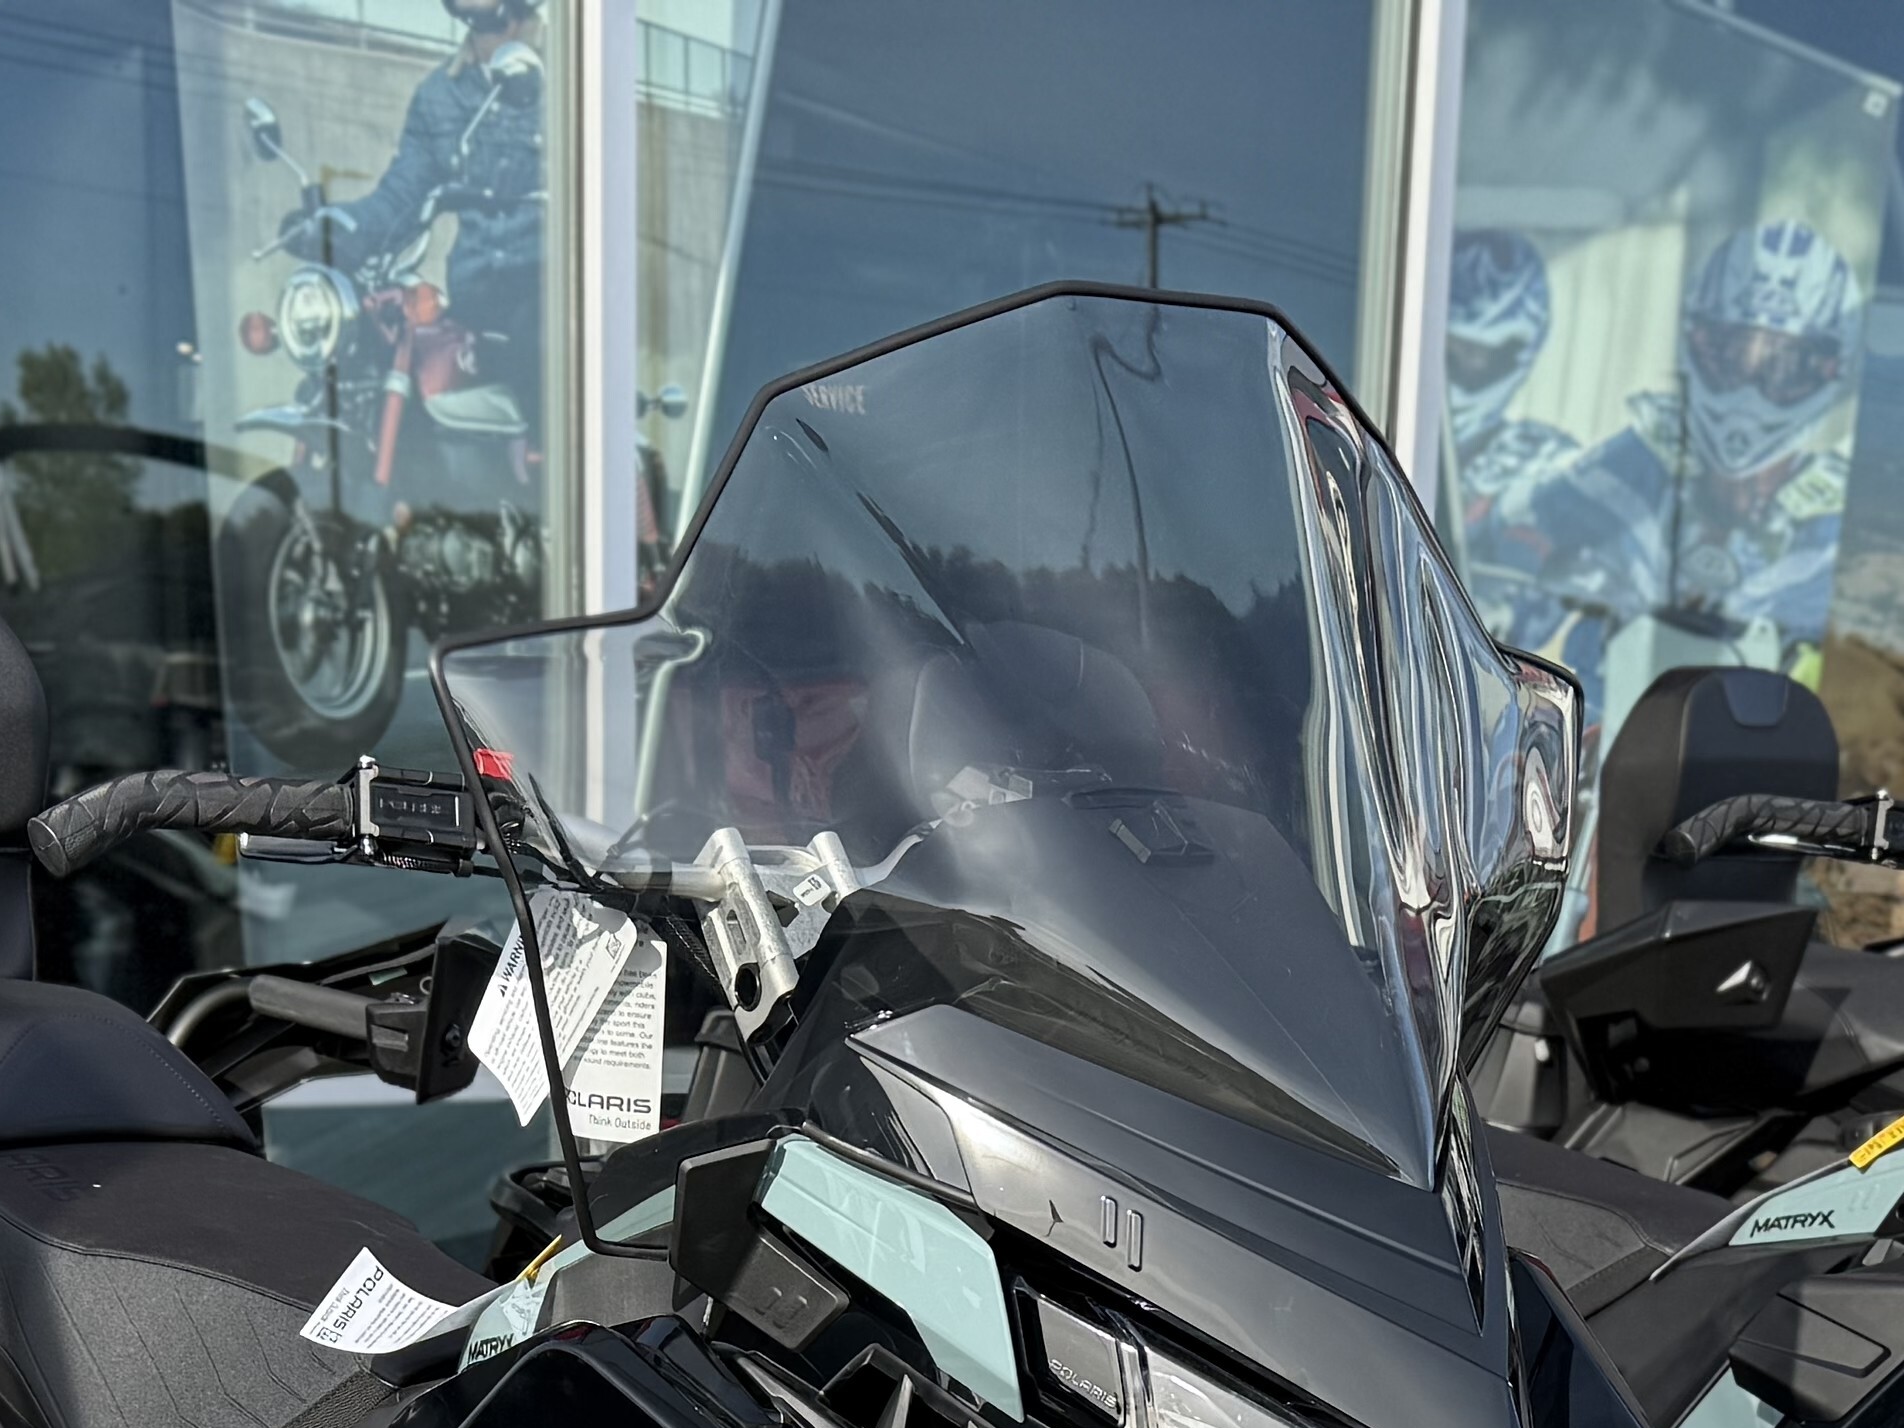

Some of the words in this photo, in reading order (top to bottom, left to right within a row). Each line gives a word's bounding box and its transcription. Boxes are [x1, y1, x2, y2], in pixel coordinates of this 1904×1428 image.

[800, 385, 865, 415] SERVICE
[502, 933, 527, 981] WARNI
[614, 1116, 652, 1131] Outside
[1750, 1210, 1835, 1238] MATRYX
[333, 1265, 384, 1331] POLARIS
[1049, 1358, 1117, 1409] POLARIS
